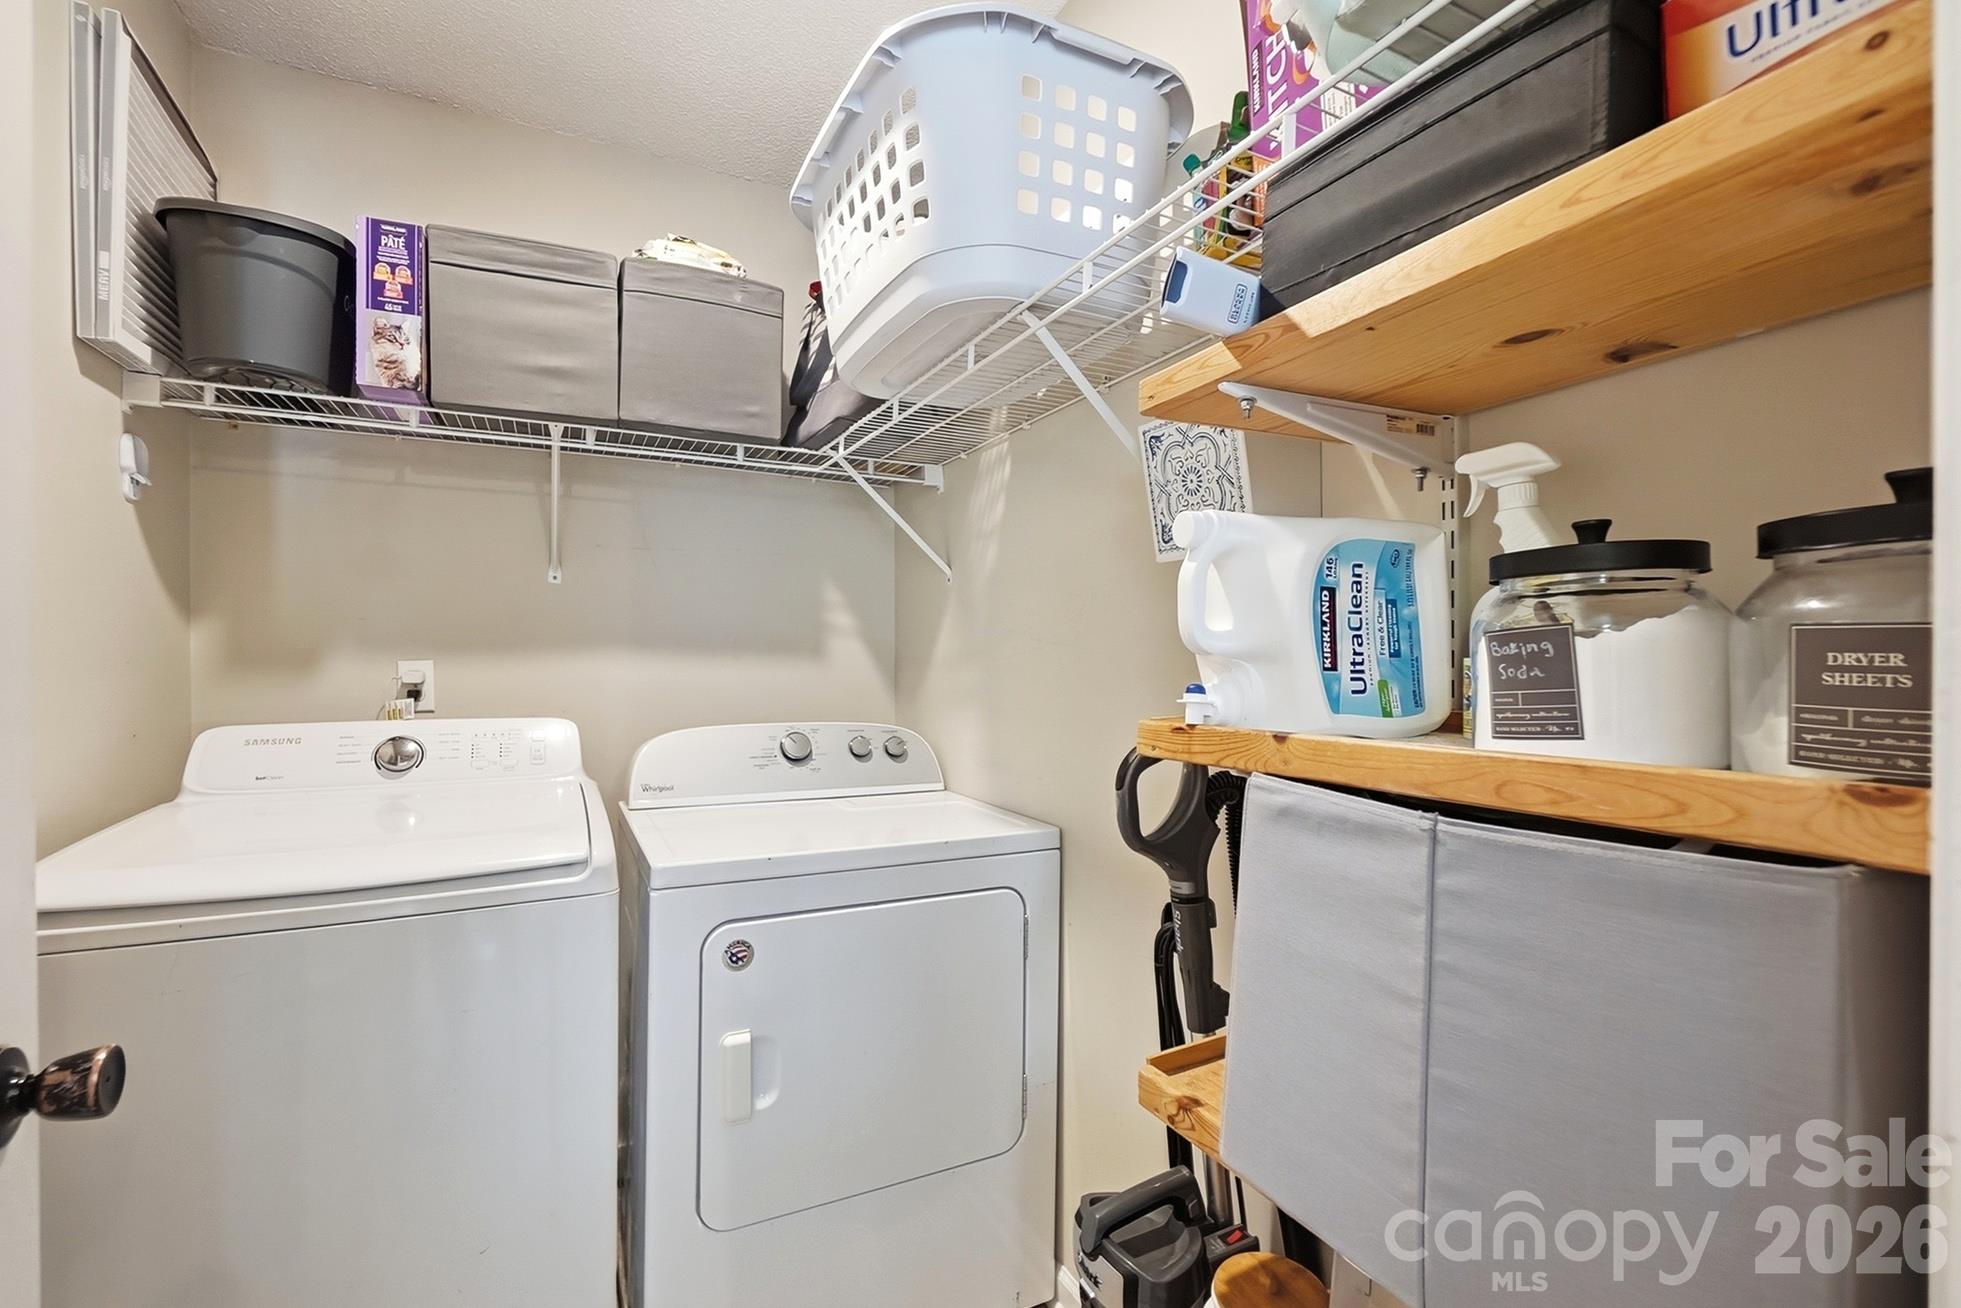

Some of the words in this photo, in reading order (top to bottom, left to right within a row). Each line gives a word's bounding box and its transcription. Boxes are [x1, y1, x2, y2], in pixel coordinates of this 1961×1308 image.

[1726, 0, 1848, 58] Ultr
[381, 234, 406, 250] PÂTÉ
[98, 269, 110, 301] MERV
[1325, 557, 1334, 579] 146
[1376, 600, 1384, 625] Clear
[1321, 590, 1332, 669] KIRKLAND
[1347, 563, 1368, 695] UltraClean
[1377, 625, 1384, 635] &
[1378, 635, 1386, 656] Free
[1490, 641, 1554, 658] Baking
[1826, 652, 1908, 667] DRYER
[1498, 663, 1545, 680] Soda
[1821, 672, 1913, 688] SHEETS
[244, 737, 302, 746] SAMSUNG
[640, 783, 675, 794] Whirlpool
